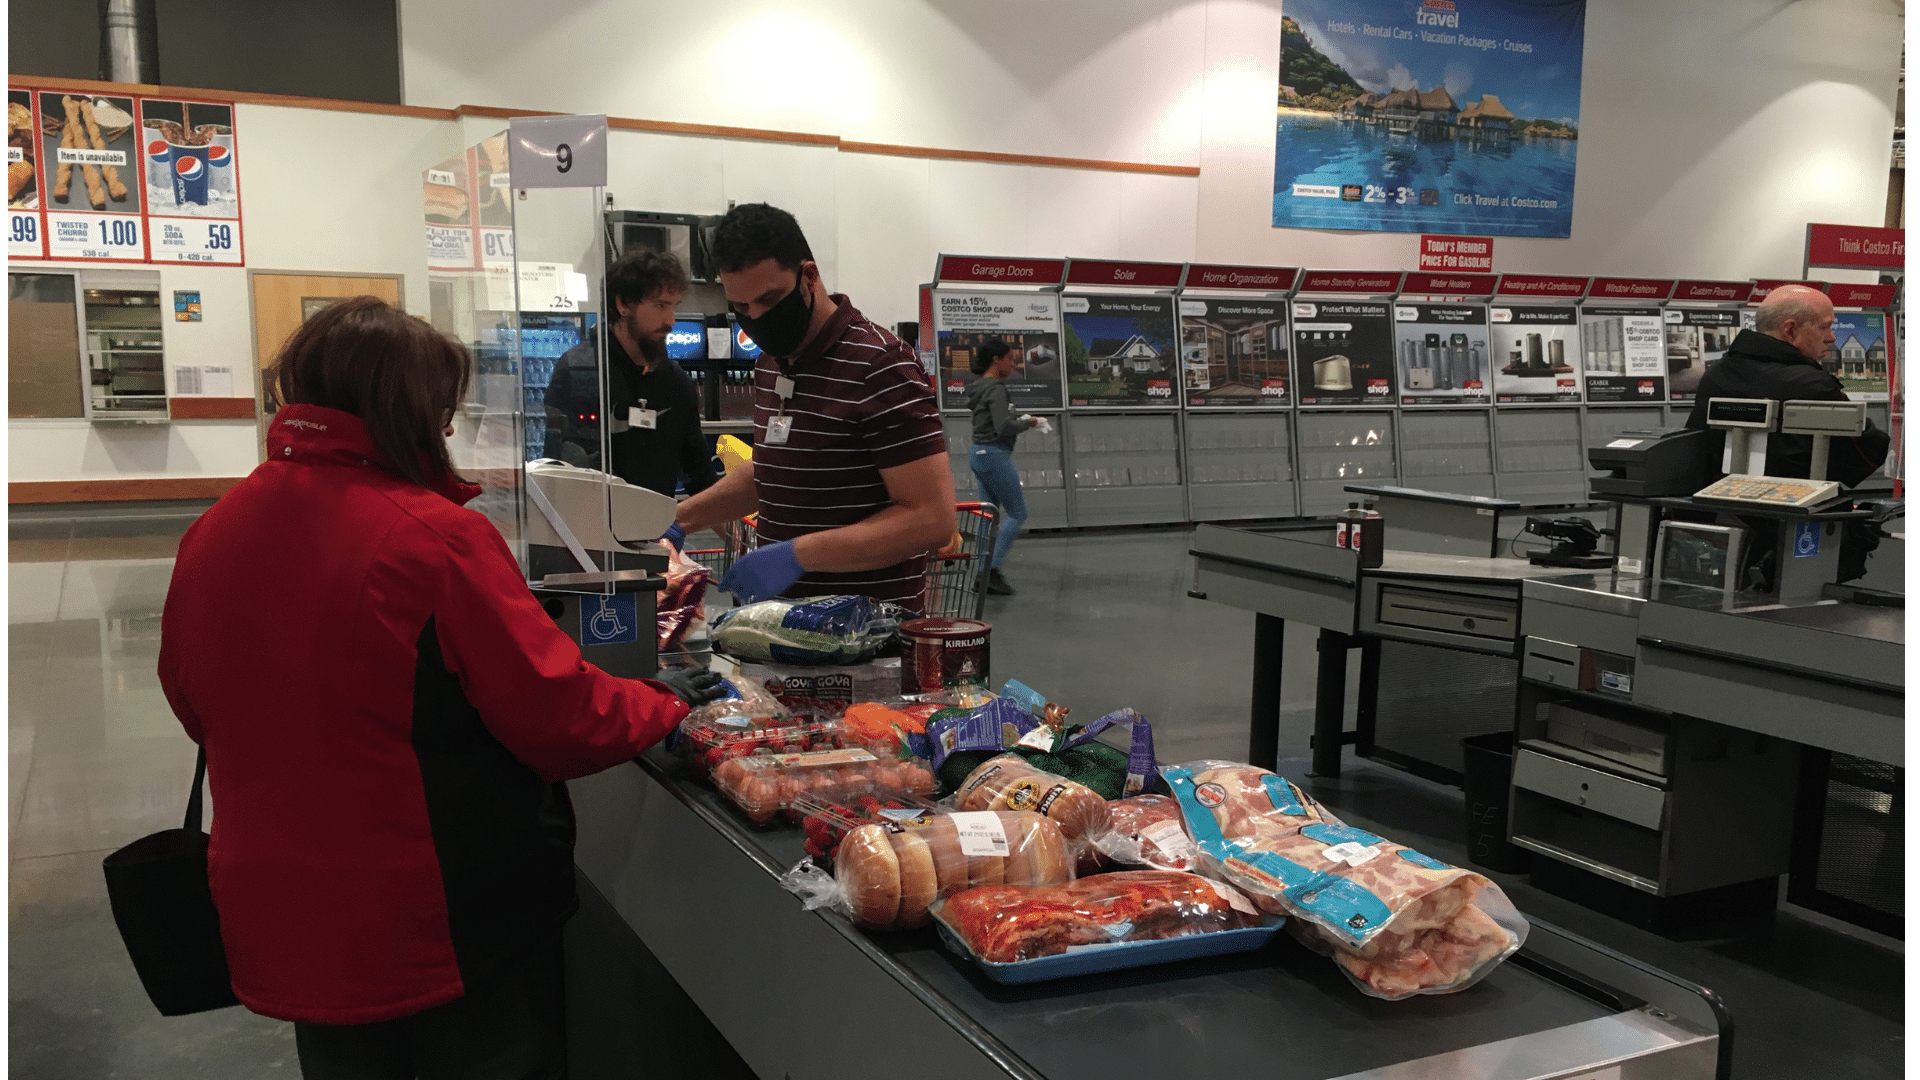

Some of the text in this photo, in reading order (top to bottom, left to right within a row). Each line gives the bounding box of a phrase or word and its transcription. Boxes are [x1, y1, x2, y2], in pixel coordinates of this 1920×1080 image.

[1416, 7, 1459, 28] travel
[1327, 20, 1533, 54] Hotels Rental Cars Vacation Packages Cruises
[8, 150, 20, 159] ble
[61, 152, 124, 164] Item is unavailable
[556, 143, 573, 174] 9
[1454, 193, 1557, 210] Click Travel at Costco.com
[56, 222, 88, 230] TWISTED
[58, 229, 87, 237] CHURRO
[98, 219, 137, 246] 1.00
[164, 231, 184, 239] SODA
[205, 224, 232, 249] .59
[1427, 239, 1486, 254] TODAY'S MEMBER
[1839, 238, 1905, 255] Think Costco Fir
[97, 250, 112, 258] cal.
[1421, 254, 1491, 268] PRICE FOR GASOLINE
[971, 263, 1034, 278] Garage Doors
[1114, 269, 1137, 281] Solar
[1202, 271, 1279, 286] Home Organization
[1310, 278, 1390, 288] Home Standby Generators
[1429, 279, 1472, 290] Water Heaters
[1503, 281, 1581, 293] Heating and Air Conditioning
[1604, 283, 1658, 295] Window Fashions
[1689, 286, 1737, 298] Custom Flooring
[549, 295, 573, 309] .25
[969, 297, 988, 306] 15%
[994, 306, 1014, 314] CARD
[1112, 304, 1130, 312] Home,
[1217, 305, 1241, 315] Discover
[1241, 306, 1257, 314] More
[1257, 306, 1275, 316] Space
[1321, 305, 1344, 314] Protect
[1344, 305, 1361, 314] What
[1361, 306, 1385, 314] Matters
[1718, 314, 1733, 322] eauty
[666, 332, 701, 347] pepsi
[1588, 379, 1609, 387] GRABER
[947, 385, 966, 394] shop
[1147, 385, 1172, 398] shop
[1261, 385, 1285, 397] shop
[1367, 385, 1390, 396] shop
[1463, 386, 1484, 398] shop
[1557, 385, 1577, 396] shop
[1638, 385, 1655, 396] shop
[944, 636, 985, 649] KIRKLAND
[785, 676, 813, 690] GOYA
[817, 674, 851, 688] GOYA
[1477, 833, 1494, 857] 5
